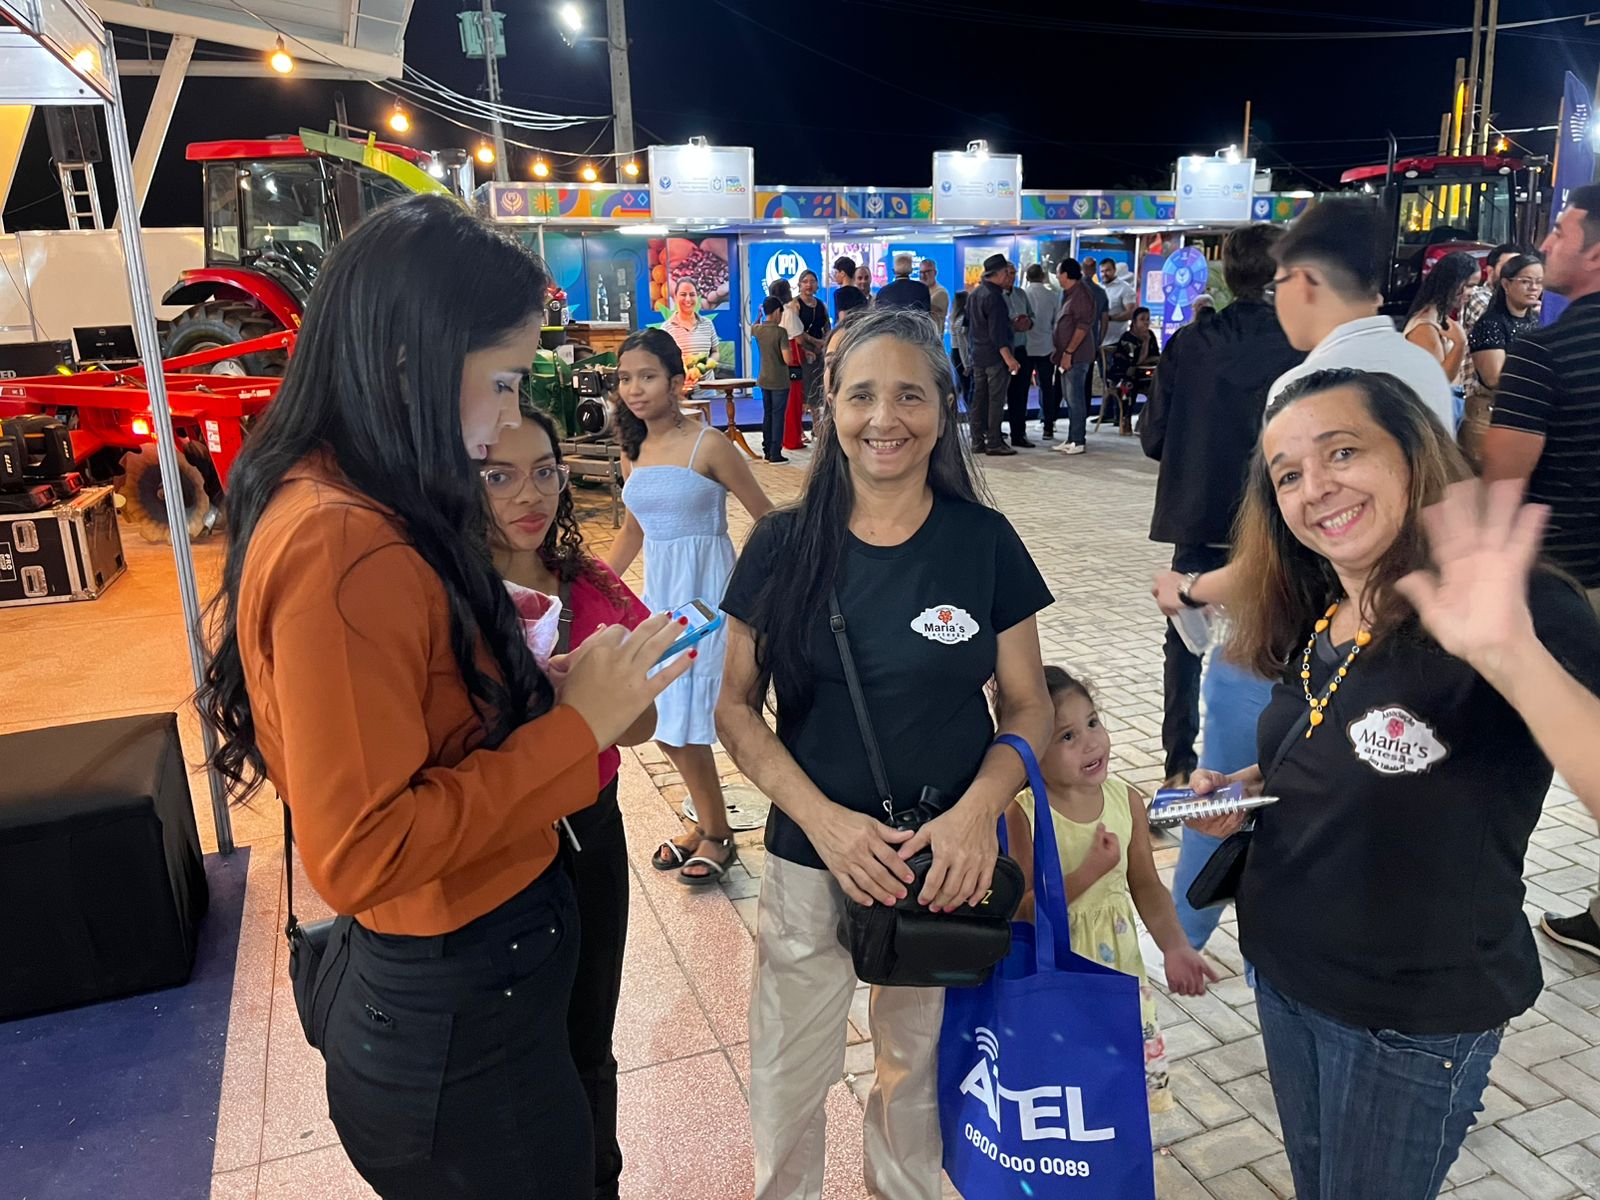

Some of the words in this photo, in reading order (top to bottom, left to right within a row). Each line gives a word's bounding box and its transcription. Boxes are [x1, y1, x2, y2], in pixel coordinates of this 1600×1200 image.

[778, 254, 796, 275] IPA
[1359, 728, 1428, 758] Maria's
[964, 1123, 998, 1161] 0800
[1000, 1152, 1035, 1174] 000
[1040, 1156, 1090, 1178] 0089
